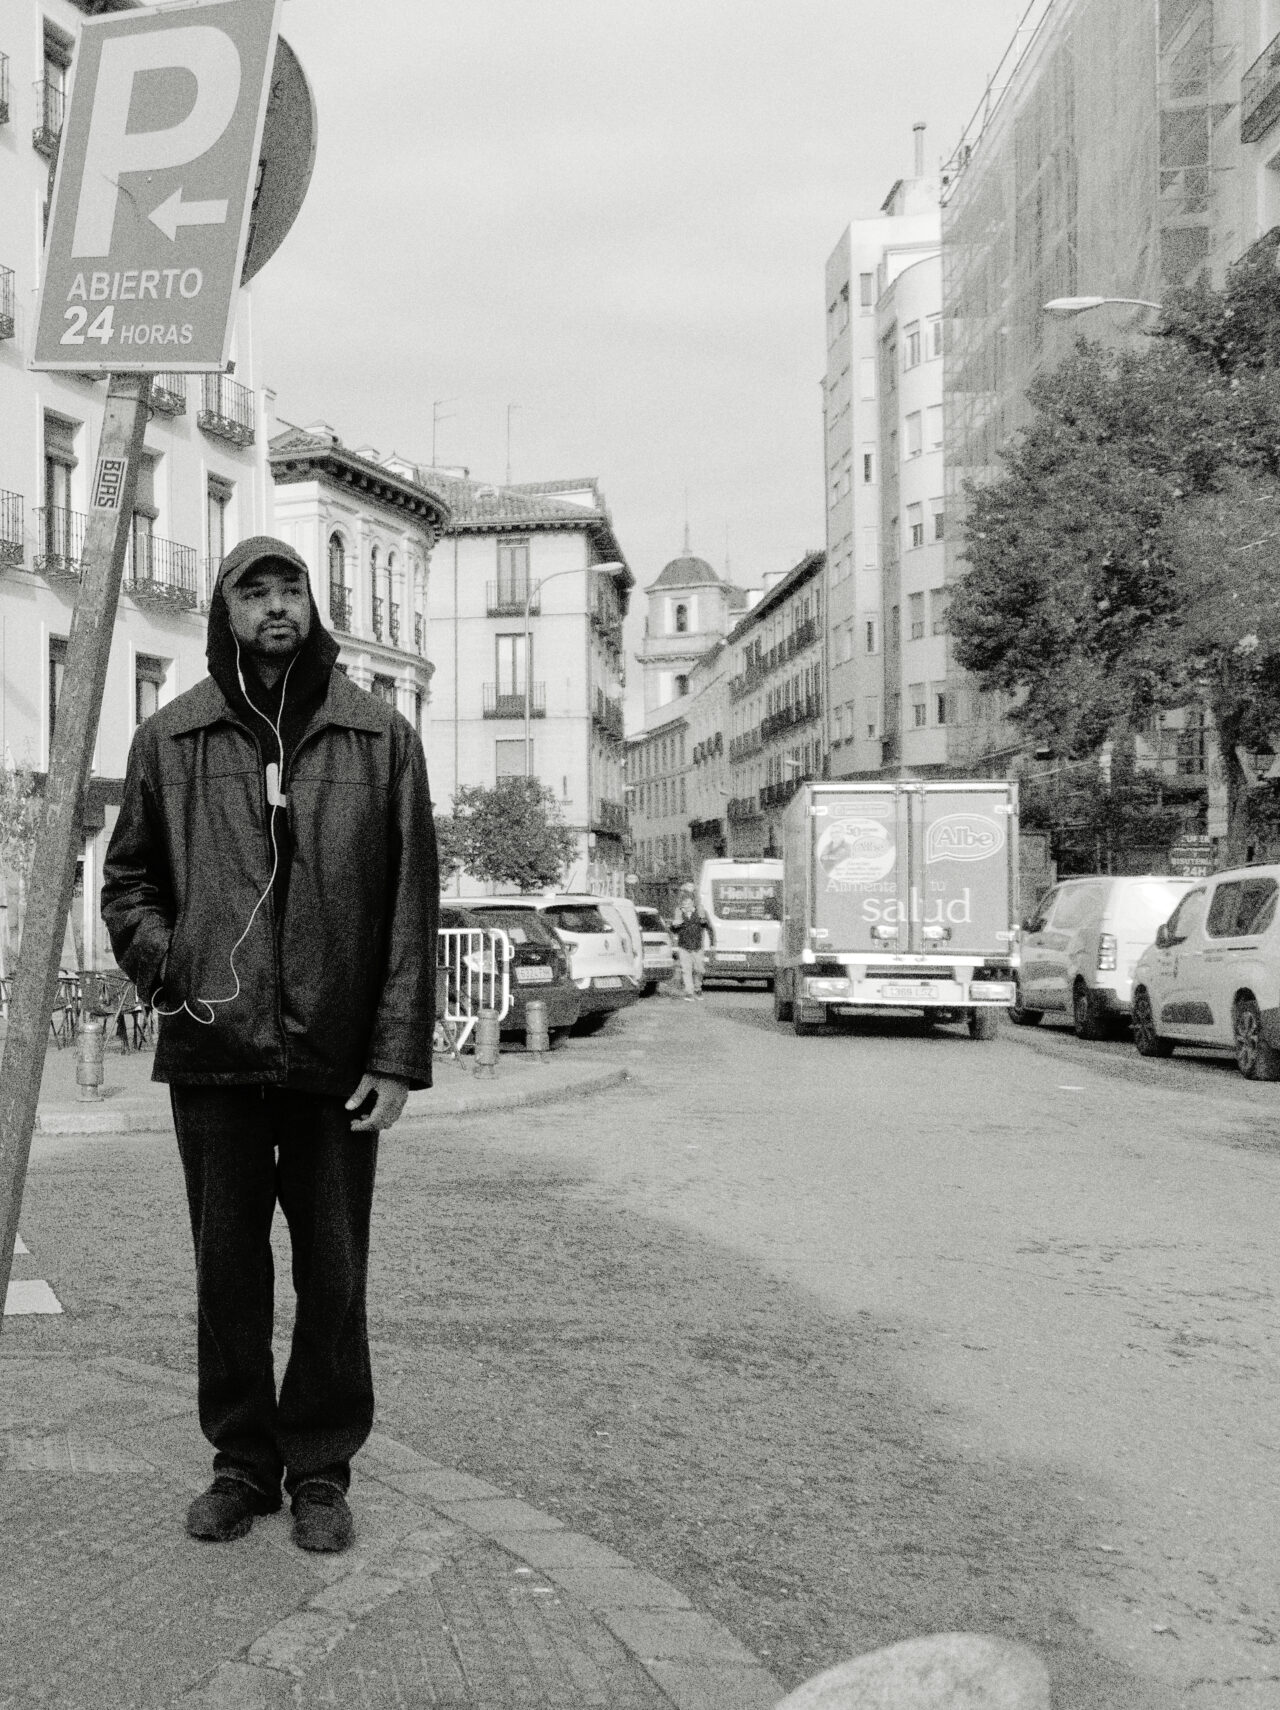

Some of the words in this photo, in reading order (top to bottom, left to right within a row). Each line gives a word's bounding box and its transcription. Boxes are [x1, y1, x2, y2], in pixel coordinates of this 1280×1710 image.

[71, 25, 241, 258] P
[66, 268, 203, 302] ABIERTO
[60, 306, 115, 345] 24
[120, 323, 194, 345] HORAS
[97, 460, 122, 508] BOAS
[935, 825, 995, 848] Albe
[825, 878, 898, 893] Alimenta
[929, 880, 946, 892] tu
[1182, 866, 1207, 877] 24H
[861, 887, 972, 923] salud
